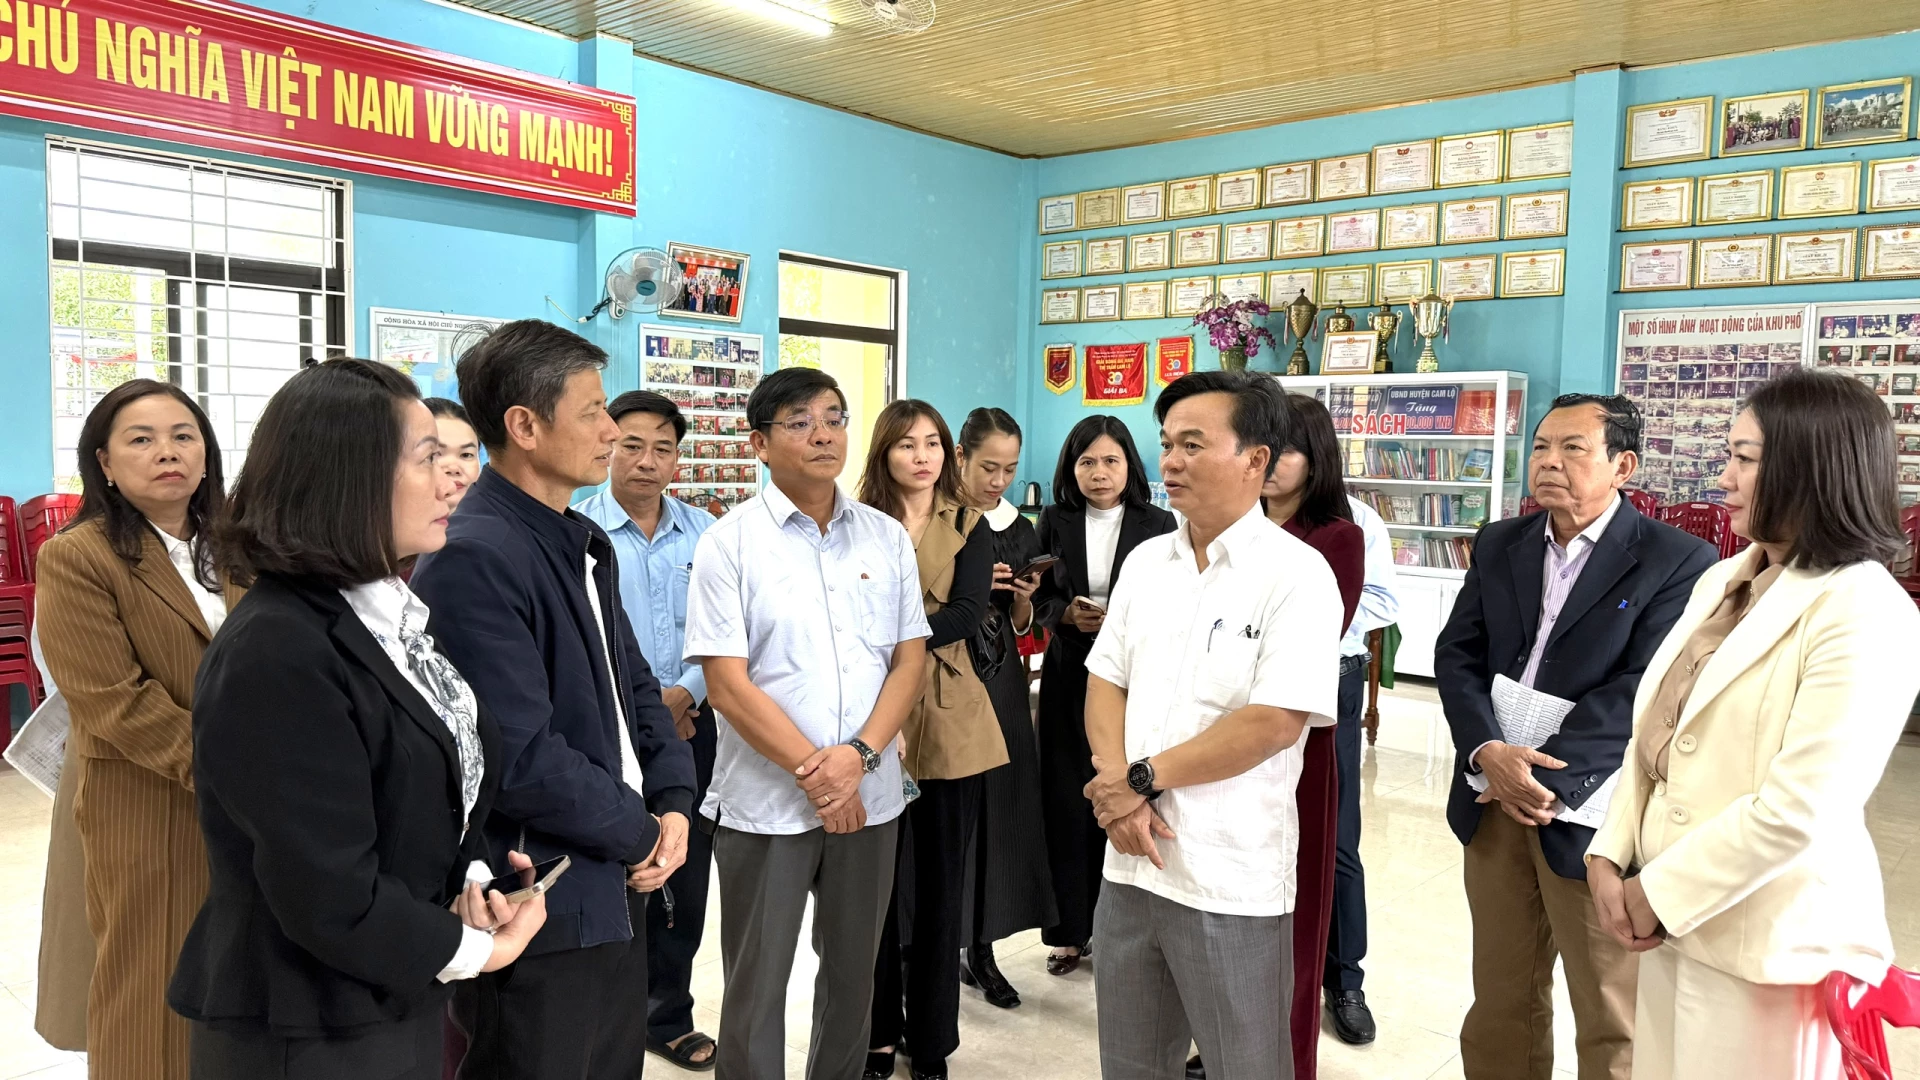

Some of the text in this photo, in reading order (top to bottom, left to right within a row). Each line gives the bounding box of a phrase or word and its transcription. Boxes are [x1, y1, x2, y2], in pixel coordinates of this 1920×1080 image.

[96, 25, 230, 104] NGHĨA
[241, 46, 322, 130] VIỆT
[334, 69, 414, 139] NAM
[425, 84, 509, 157] VỮNG
[519, 110, 613, 178] MẠNH!
[1628, 310, 1803, 337] MỘT SỐ HÌNH ẢNH HOẠT ĐỘNG CỦA KHU PHỐ
[1390, 388, 1456, 400] UBND HUYỆN CAM LỘ
[1405, 402, 1437, 414] Tặng
[1351, 409, 1406, 435] SÁCH
[1405, 415, 1453, 430] 00.000 VNĐ
